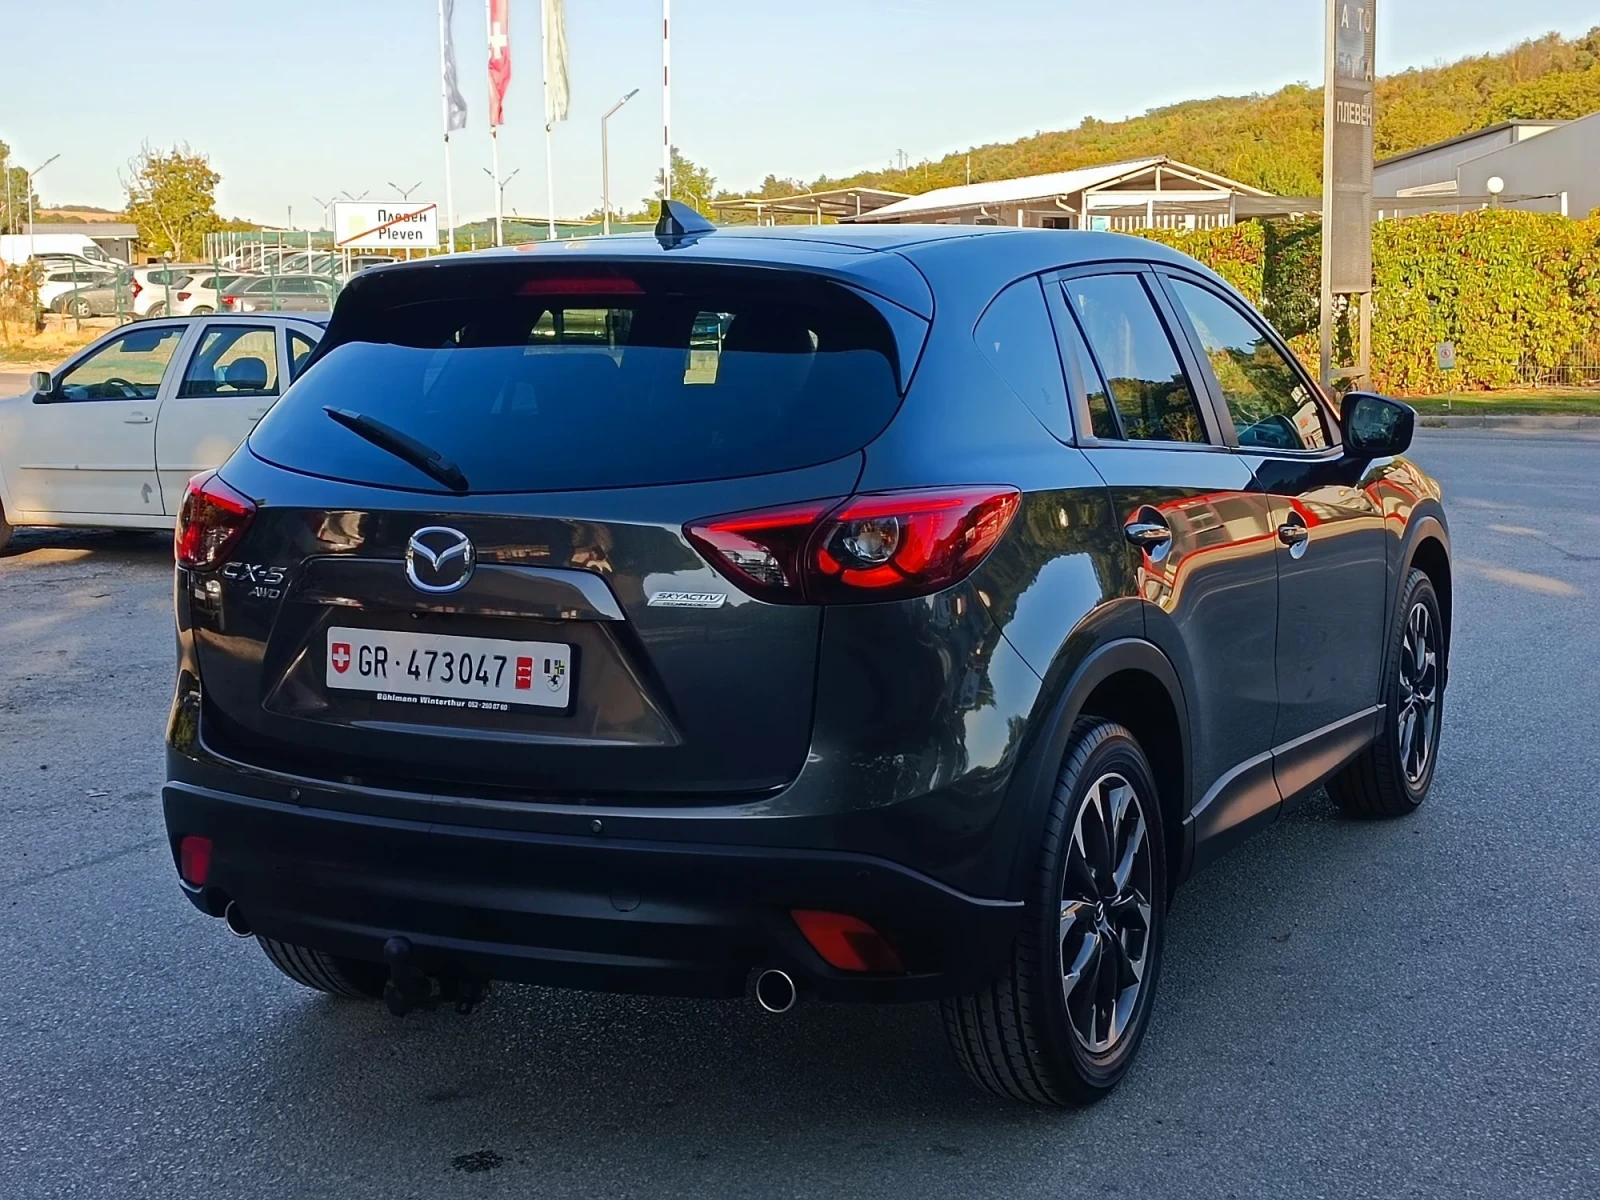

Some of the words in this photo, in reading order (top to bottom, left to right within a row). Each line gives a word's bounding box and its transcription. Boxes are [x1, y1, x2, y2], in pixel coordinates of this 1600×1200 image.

[1336, 101, 1372, 125] ПЛЕВЕН
[378, 209, 427, 222] Плевен
[379, 227, 423, 240] Pleven
[222, 561, 287, 585] CX-5
[248, 586, 280, 599] AWD
[420, 697, 465, 707] Winterthur
